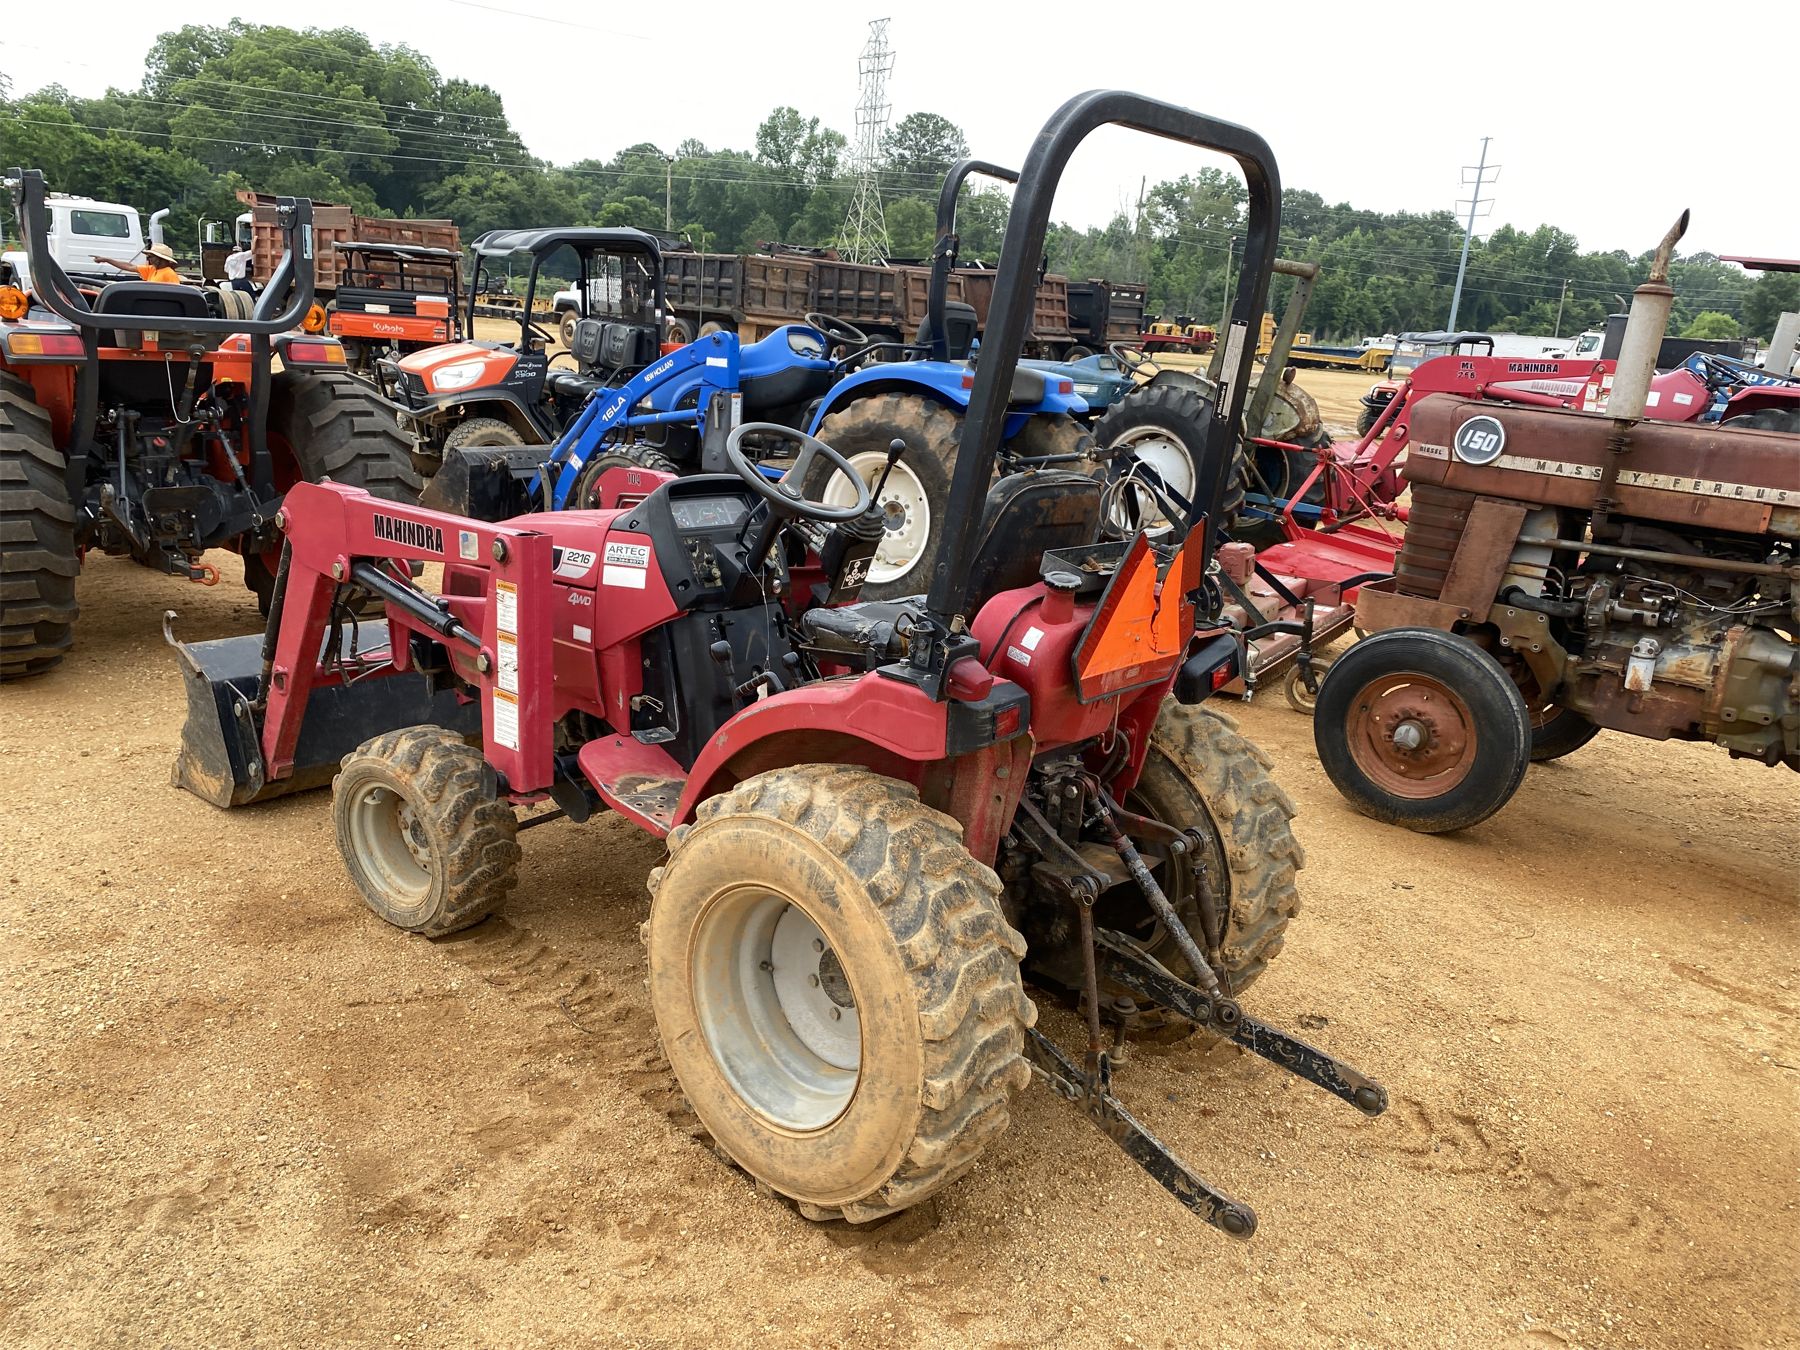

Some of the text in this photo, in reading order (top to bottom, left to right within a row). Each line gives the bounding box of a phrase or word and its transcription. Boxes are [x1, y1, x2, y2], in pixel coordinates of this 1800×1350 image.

[373, 322, 404, 333] Kubota
[654, 359, 674, 378] HOLLAND
[1508, 362, 1559, 374] MAHINDRA
[1530, 379, 1579, 394] MAHINDRA
[601, 396, 627, 422] 16LA
[1462, 429, 1499, 452] 150
[1419, 446, 1442, 456] DIESEL
[373, 513, 445, 554] MAHINDRA
[567, 551, 591, 565] 2216
[608, 545, 646, 557] ARTEC
[567, 592, 592, 606] 4WD
